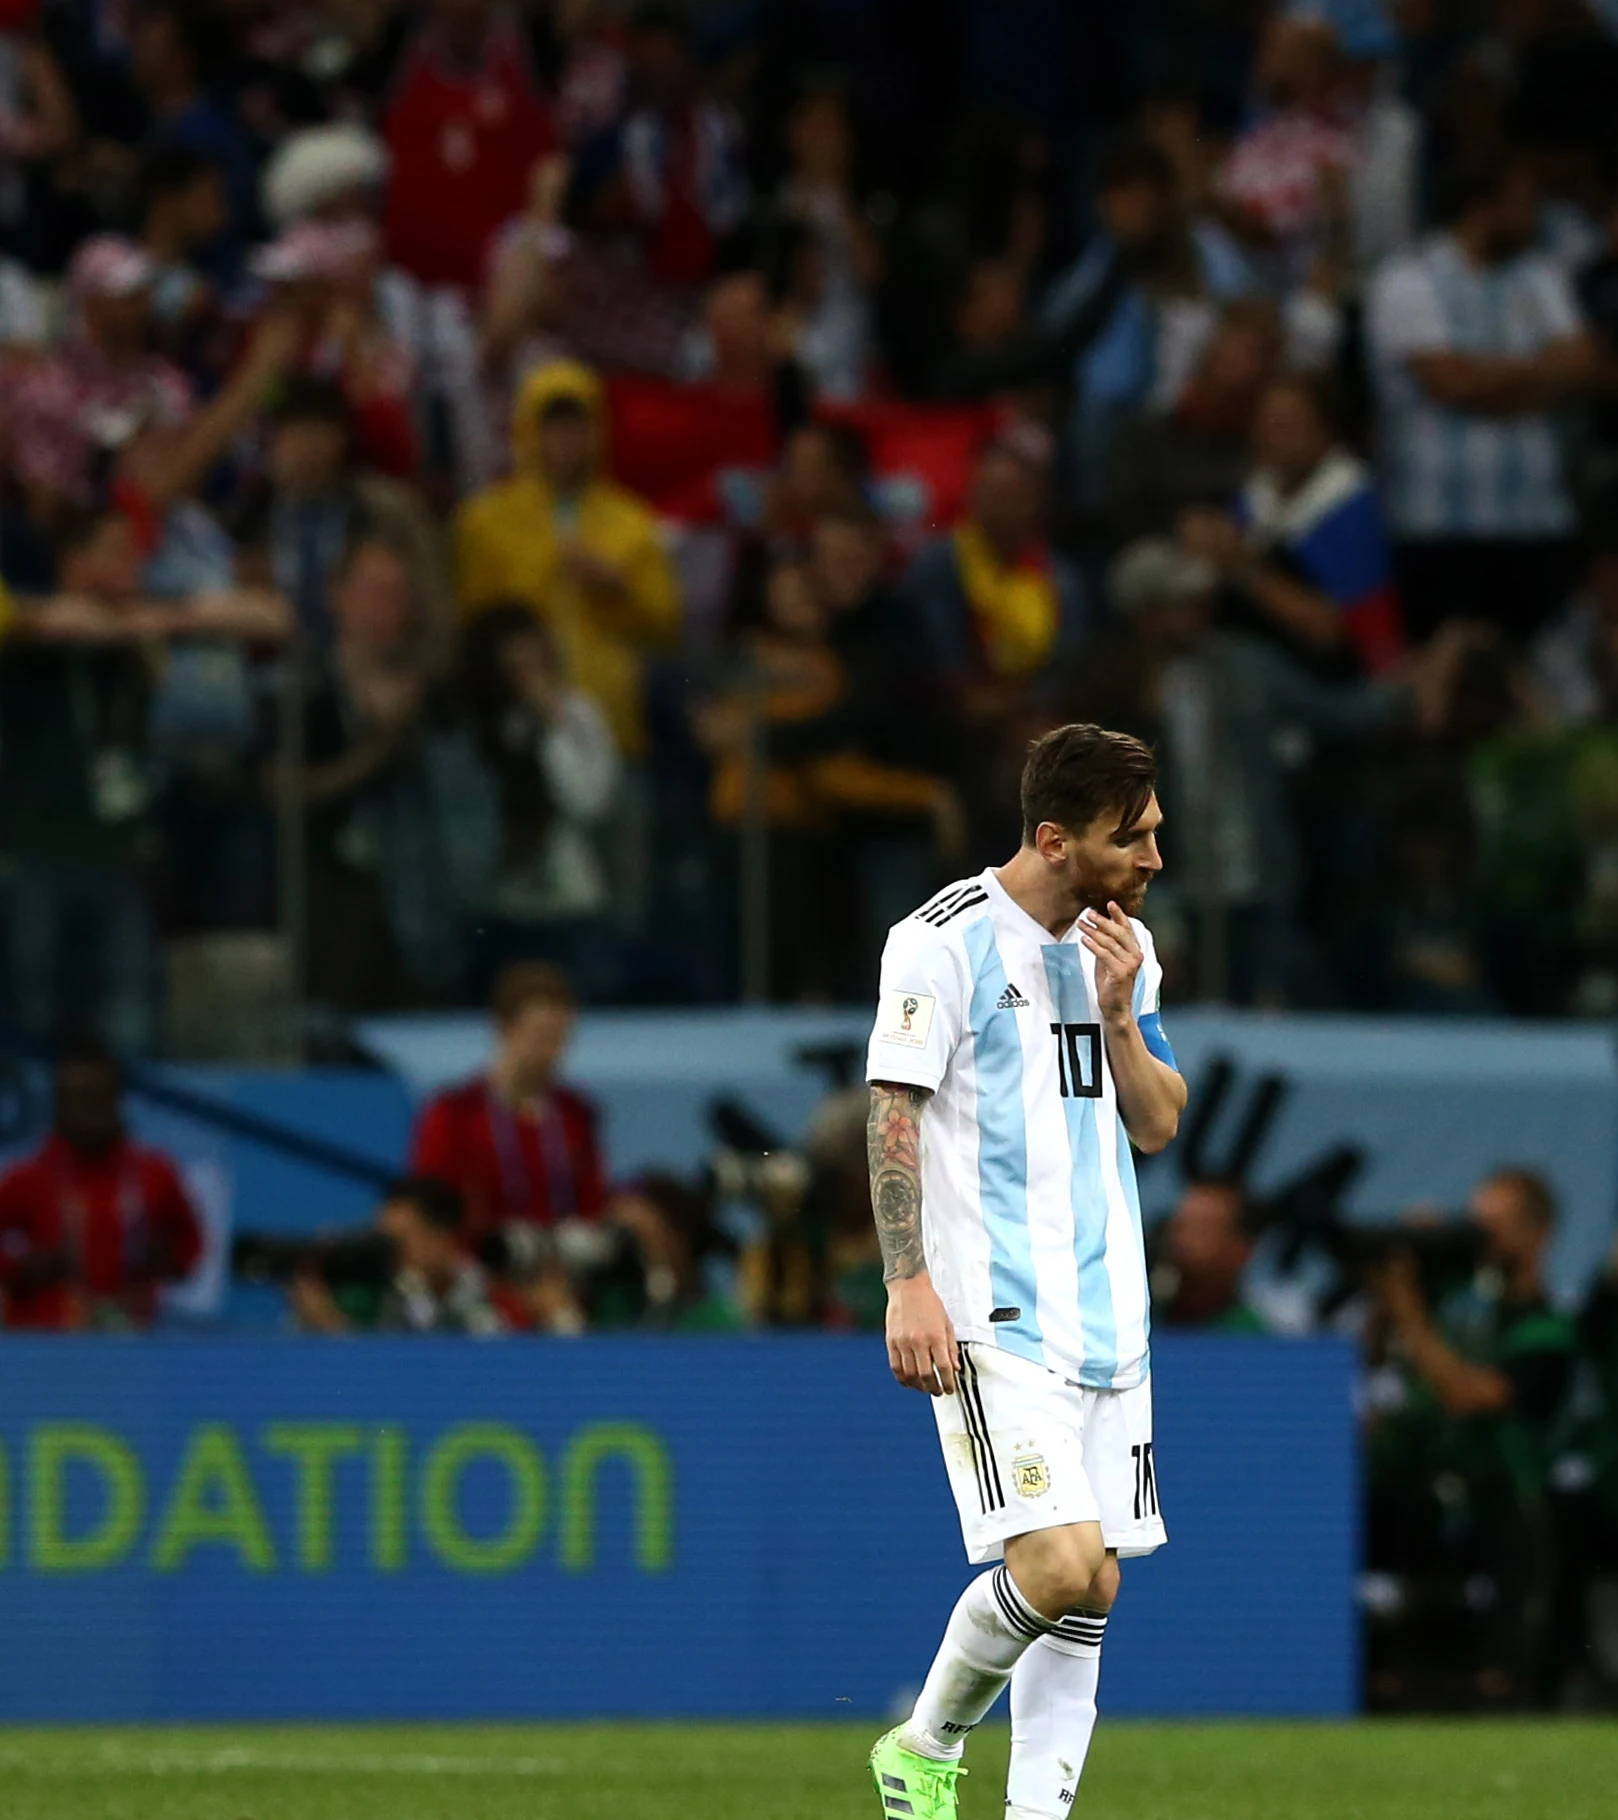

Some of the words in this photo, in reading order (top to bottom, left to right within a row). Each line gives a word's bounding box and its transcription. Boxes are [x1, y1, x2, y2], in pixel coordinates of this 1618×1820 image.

[997, 999, 1030, 1010] adidas
[1049, 1022, 1103, 1098] 10
[1022, 1466, 1043, 1485] AFA
